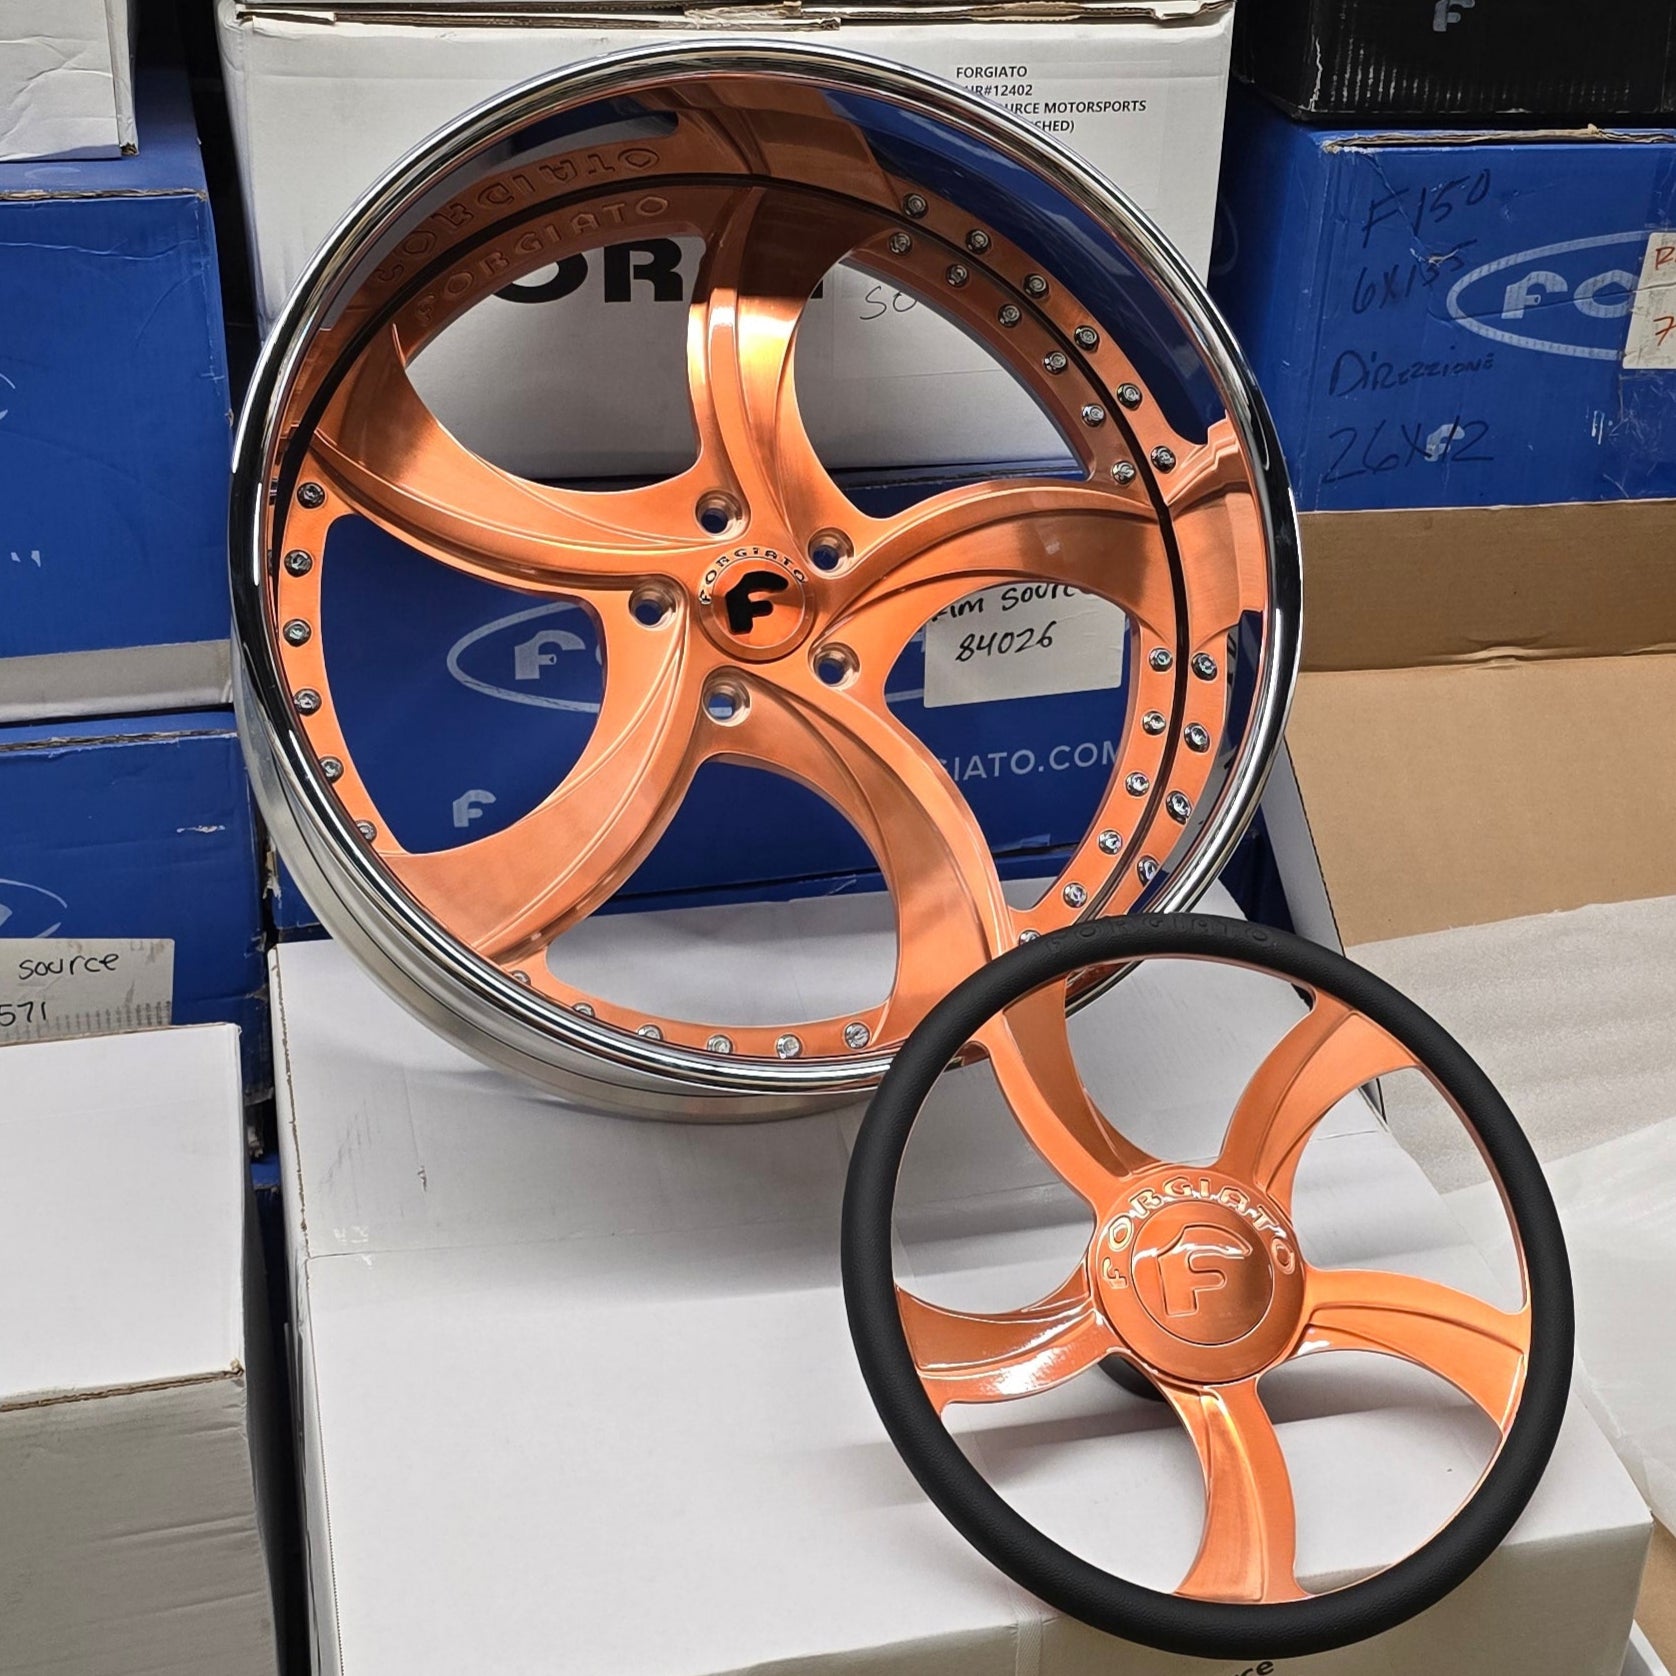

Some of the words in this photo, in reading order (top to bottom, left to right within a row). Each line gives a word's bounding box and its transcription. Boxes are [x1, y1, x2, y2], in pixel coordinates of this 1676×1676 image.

[956, 66, 1028, 79] FORGIATO
[1043, 100, 1147, 113] MOTORSPORTS
[414, 195, 669, 324] FORGIATO
[699, 547, 807, 605] FORGIATO
[725, 570, 789, 635] F
[514, 629, 602, 681] F
[955, 620, 1057, 662] 84026
[941, 740, 1116, 781] IATO.COM
[452, 789, 497, 828] F
[1046, 914, 1273, 949] FORGIATO
[19, 953, 119, 980] source
[1102, 1176, 1295, 1290] FORGIATO
[1157, 1222, 1254, 1317] F
